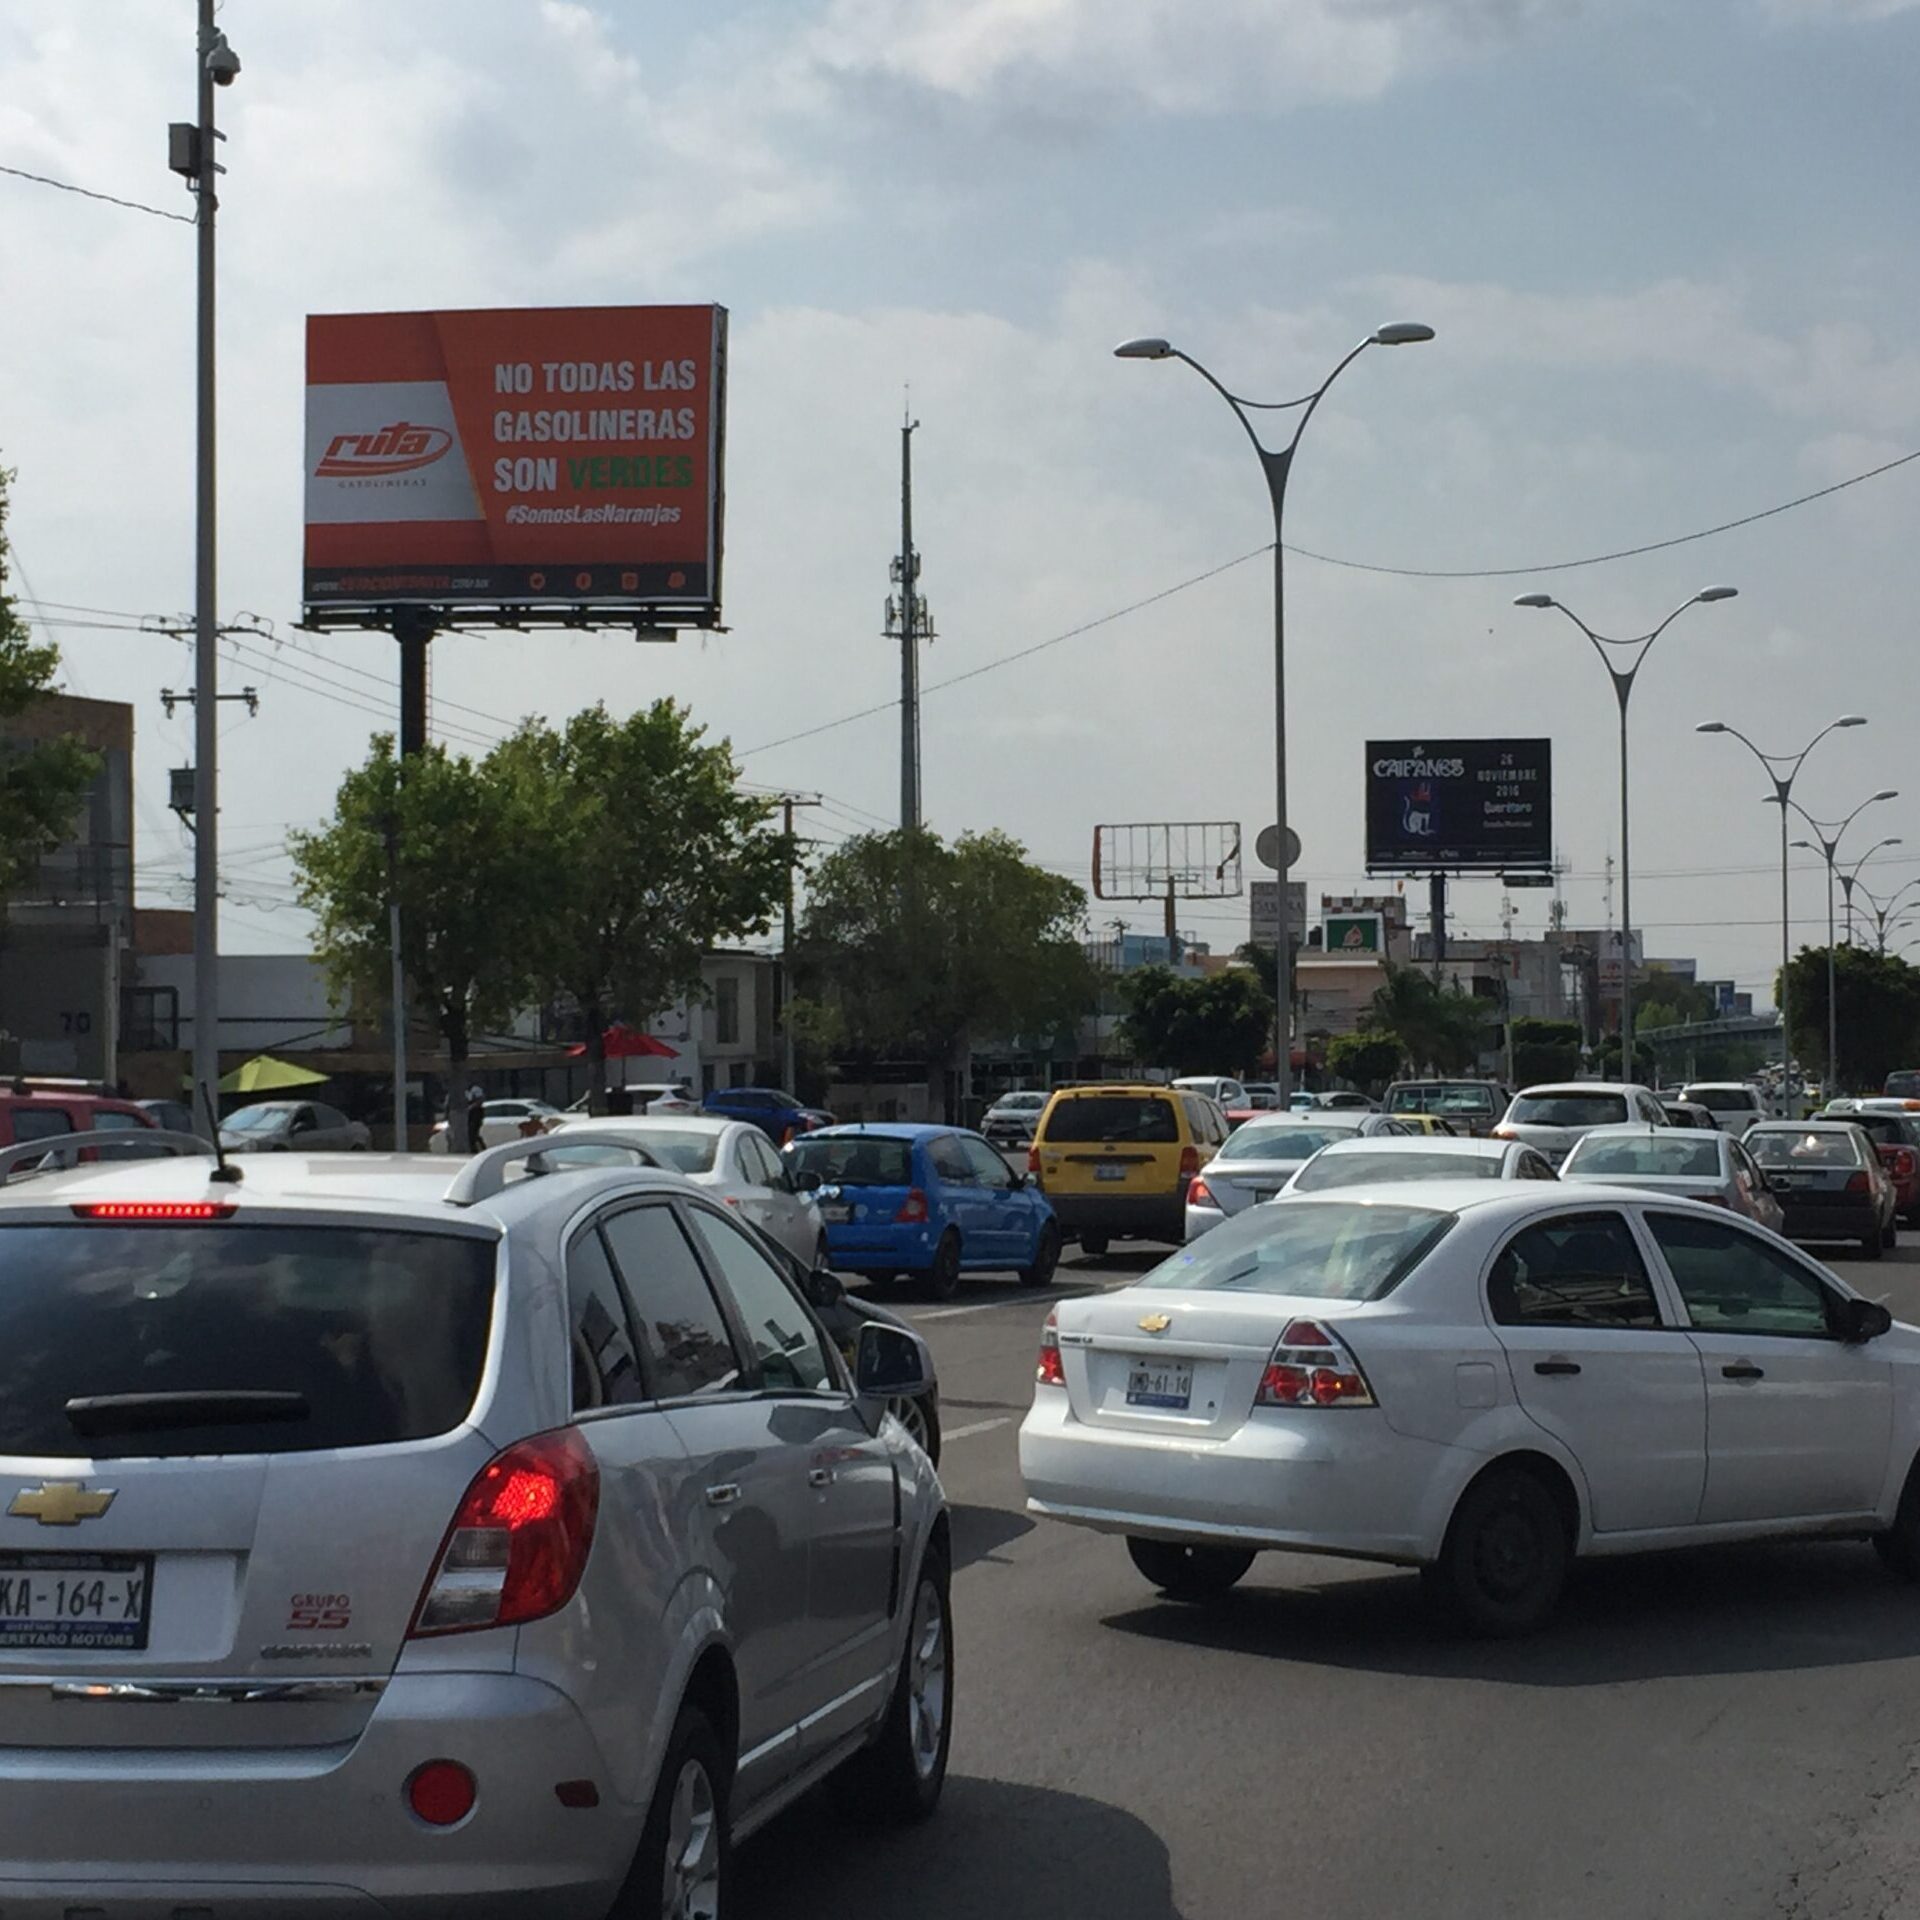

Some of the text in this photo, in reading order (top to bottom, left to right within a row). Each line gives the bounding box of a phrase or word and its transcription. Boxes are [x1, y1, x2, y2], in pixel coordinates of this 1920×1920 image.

[495, 360, 696, 393] NO TODAS LAS
[494, 408, 695, 442] GASOLINERAS
[494, 455, 694, 492] SON VERDES
[506, 503, 681, 526] #SomosLasNaranjas
[1373, 757, 1465, 777] CAIFANES
[291, 1594, 350, 1608] GRUPO
[71, 1632, 135, 1646] MOTORS
